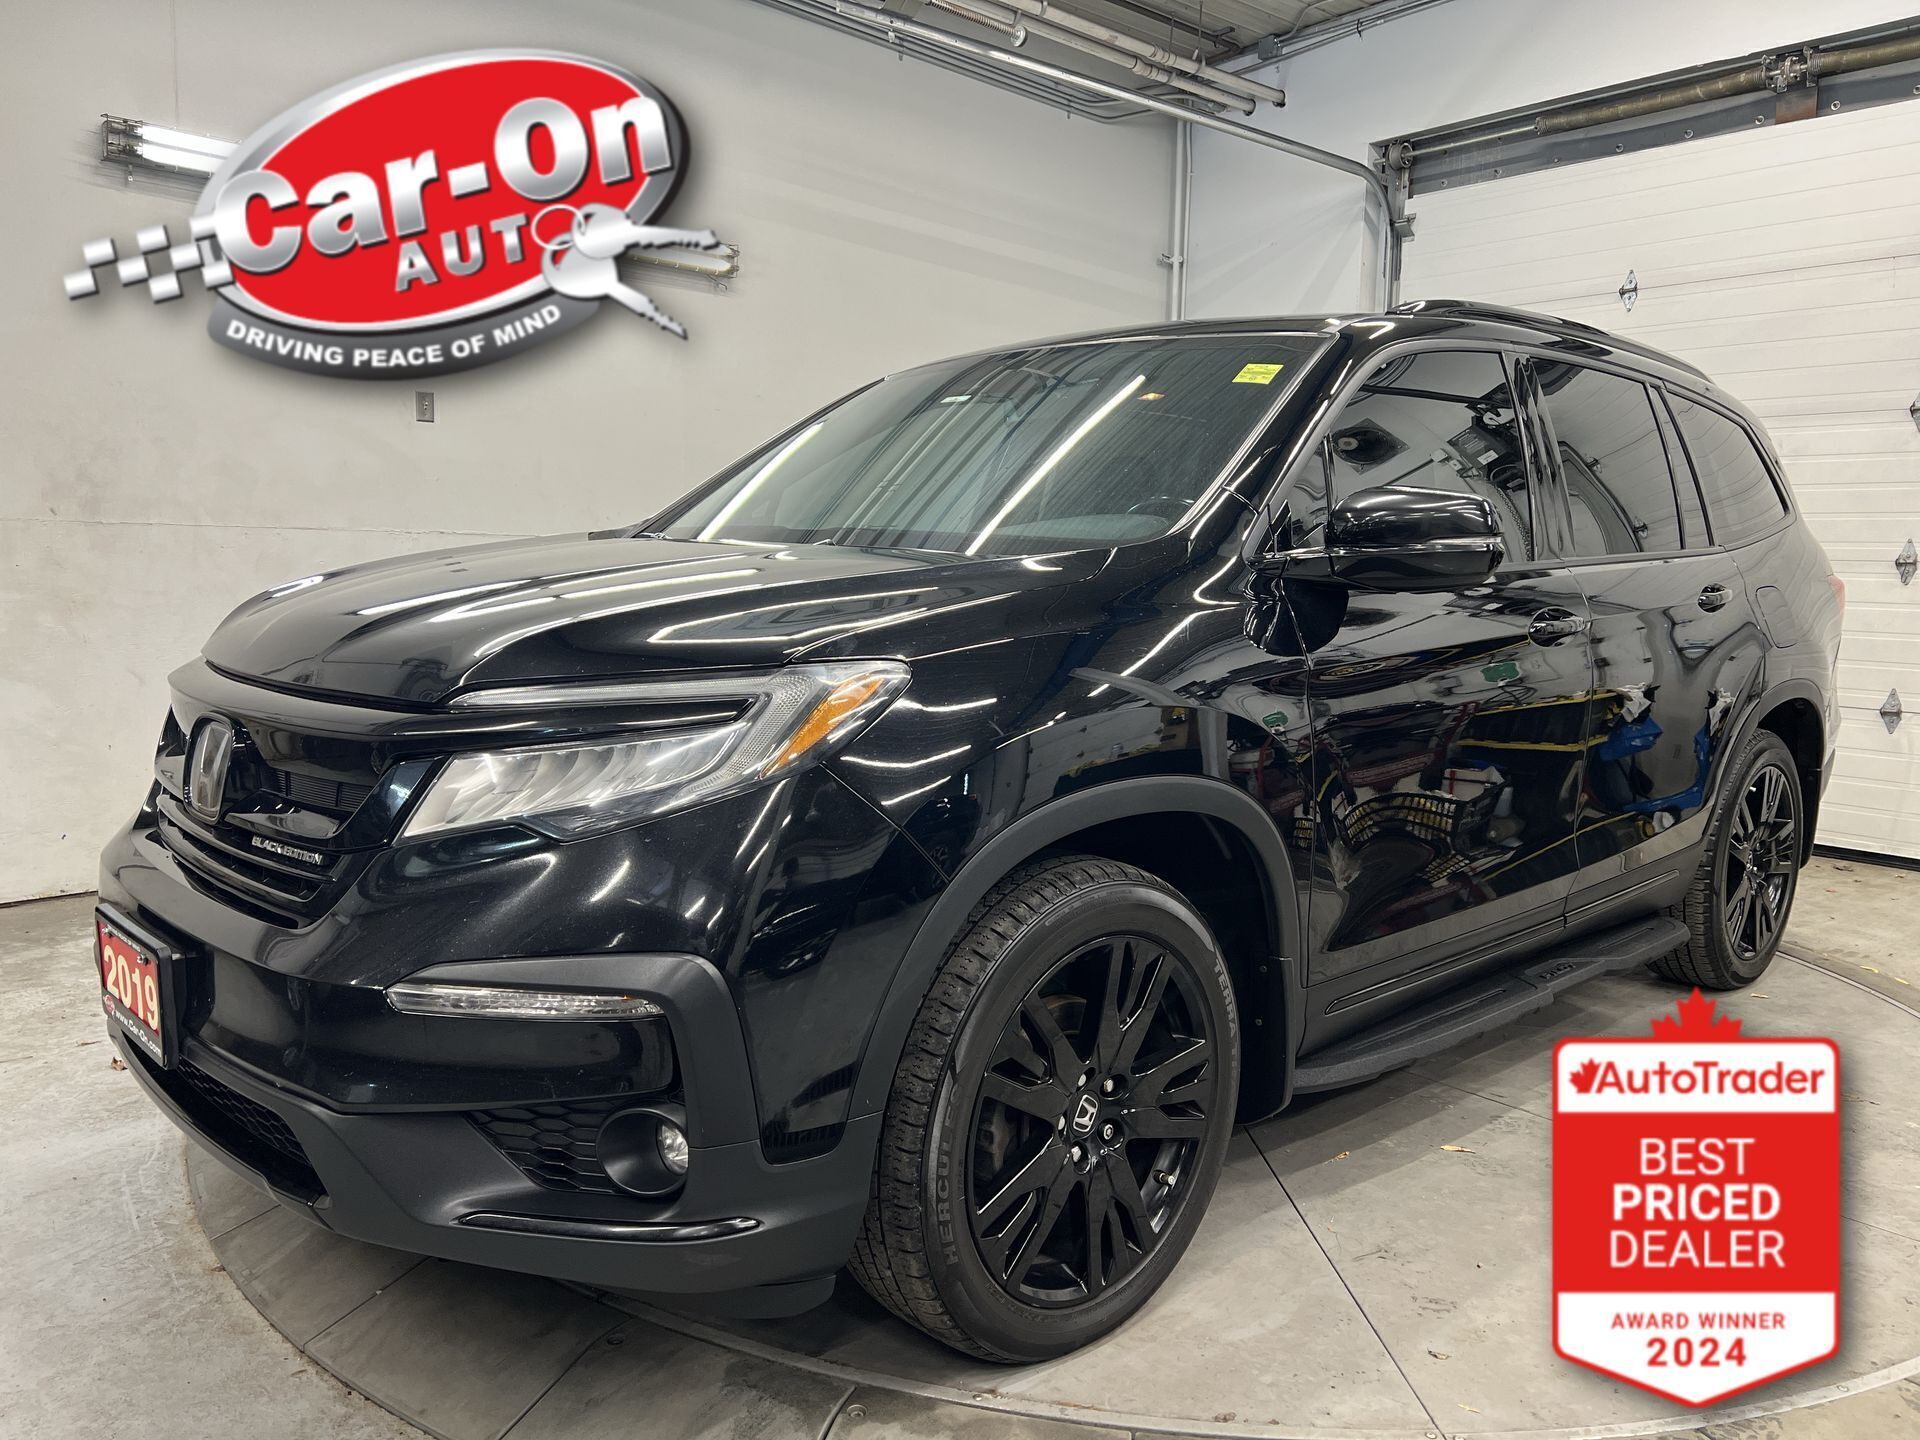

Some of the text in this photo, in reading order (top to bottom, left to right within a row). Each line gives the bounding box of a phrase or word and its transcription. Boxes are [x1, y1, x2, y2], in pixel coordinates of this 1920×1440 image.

[251, 834, 323, 865] BLACK EDITION
[103, 944, 159, 1031] 2019
